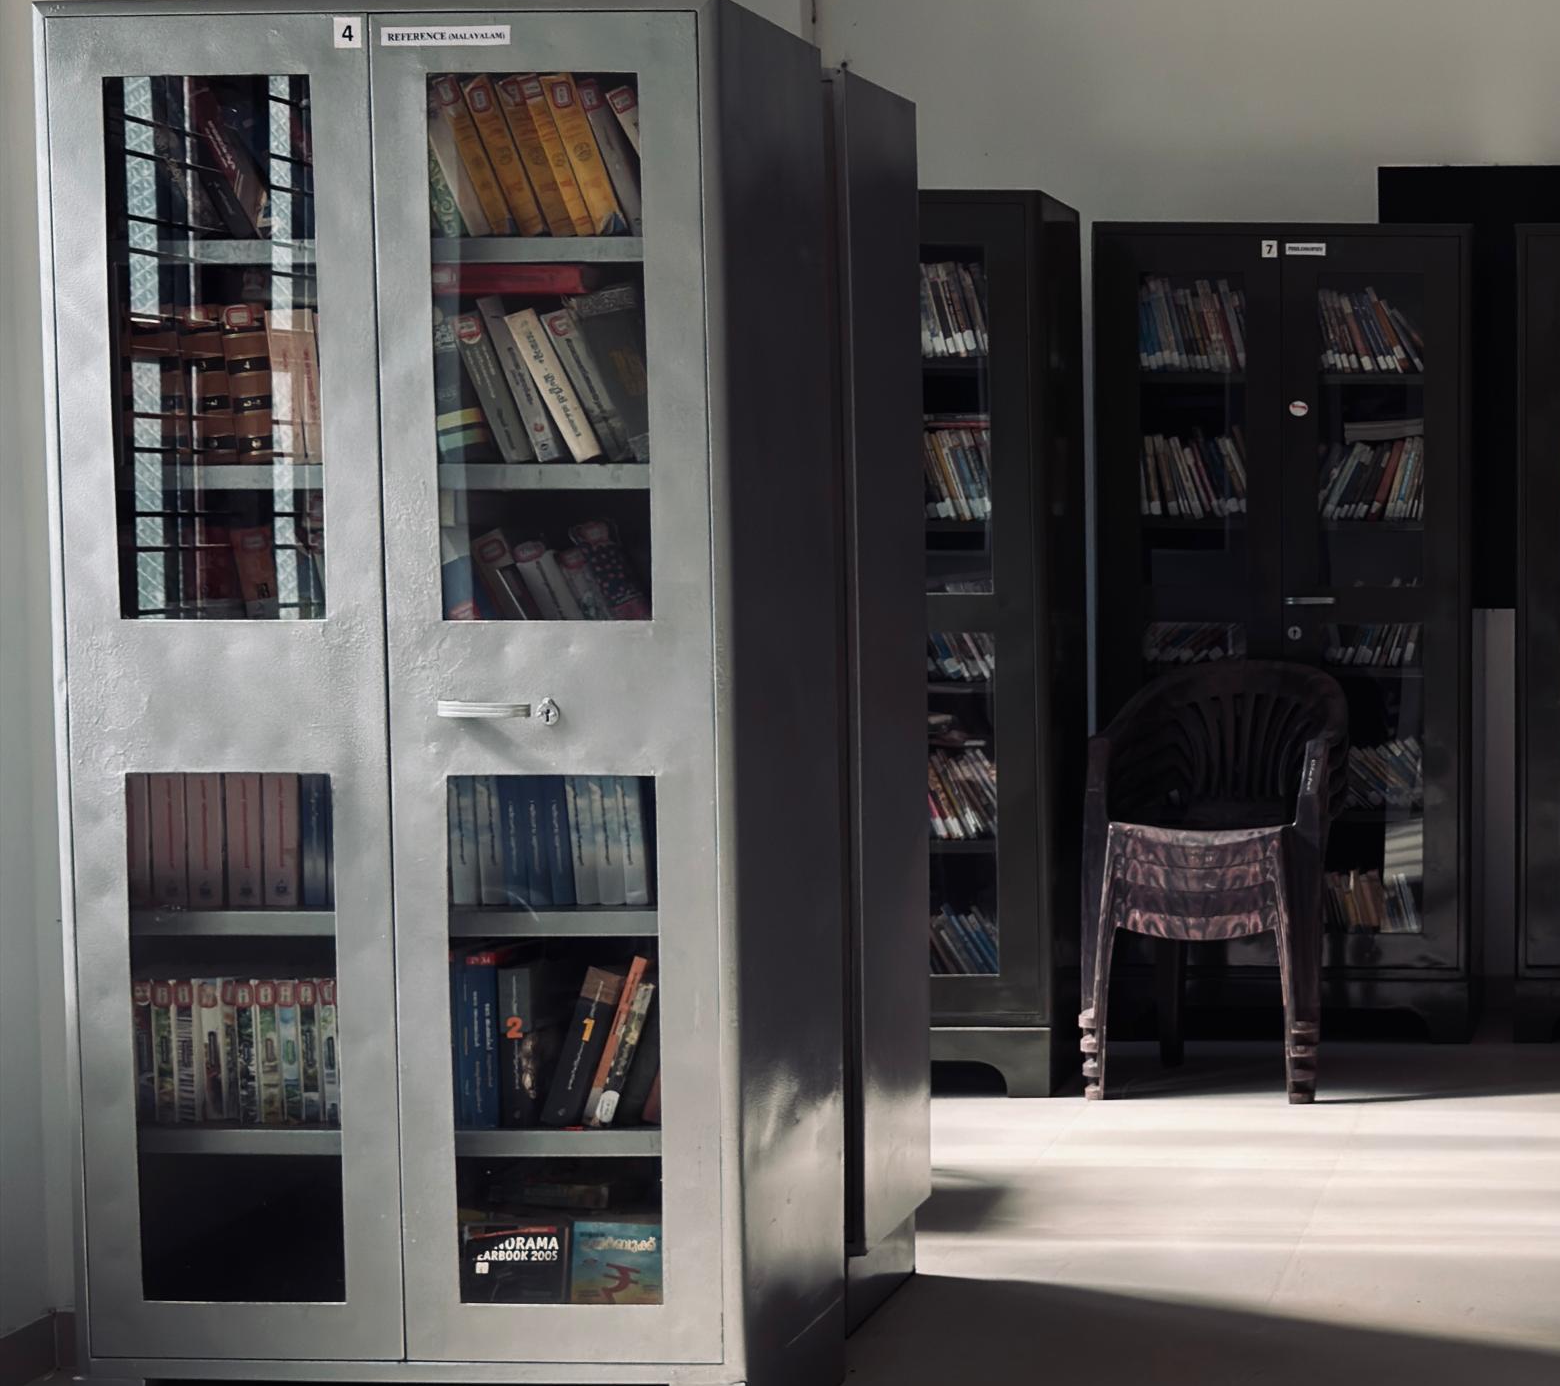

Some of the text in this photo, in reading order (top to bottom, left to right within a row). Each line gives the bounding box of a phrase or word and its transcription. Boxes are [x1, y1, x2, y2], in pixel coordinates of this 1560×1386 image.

[341, 24, 354, 42] 4
[387, 31, 505, 43] REFERENCE (MALAYALAM)
[1265, 244, 1274, 254] 7
[507, 1016, 523, 1038] 2
[581, 1017, 595, 1043] 1
[494, 1236, 559, 1251] ORAMA
[473, 1250, 558, 1261] EARBOOK 2005
